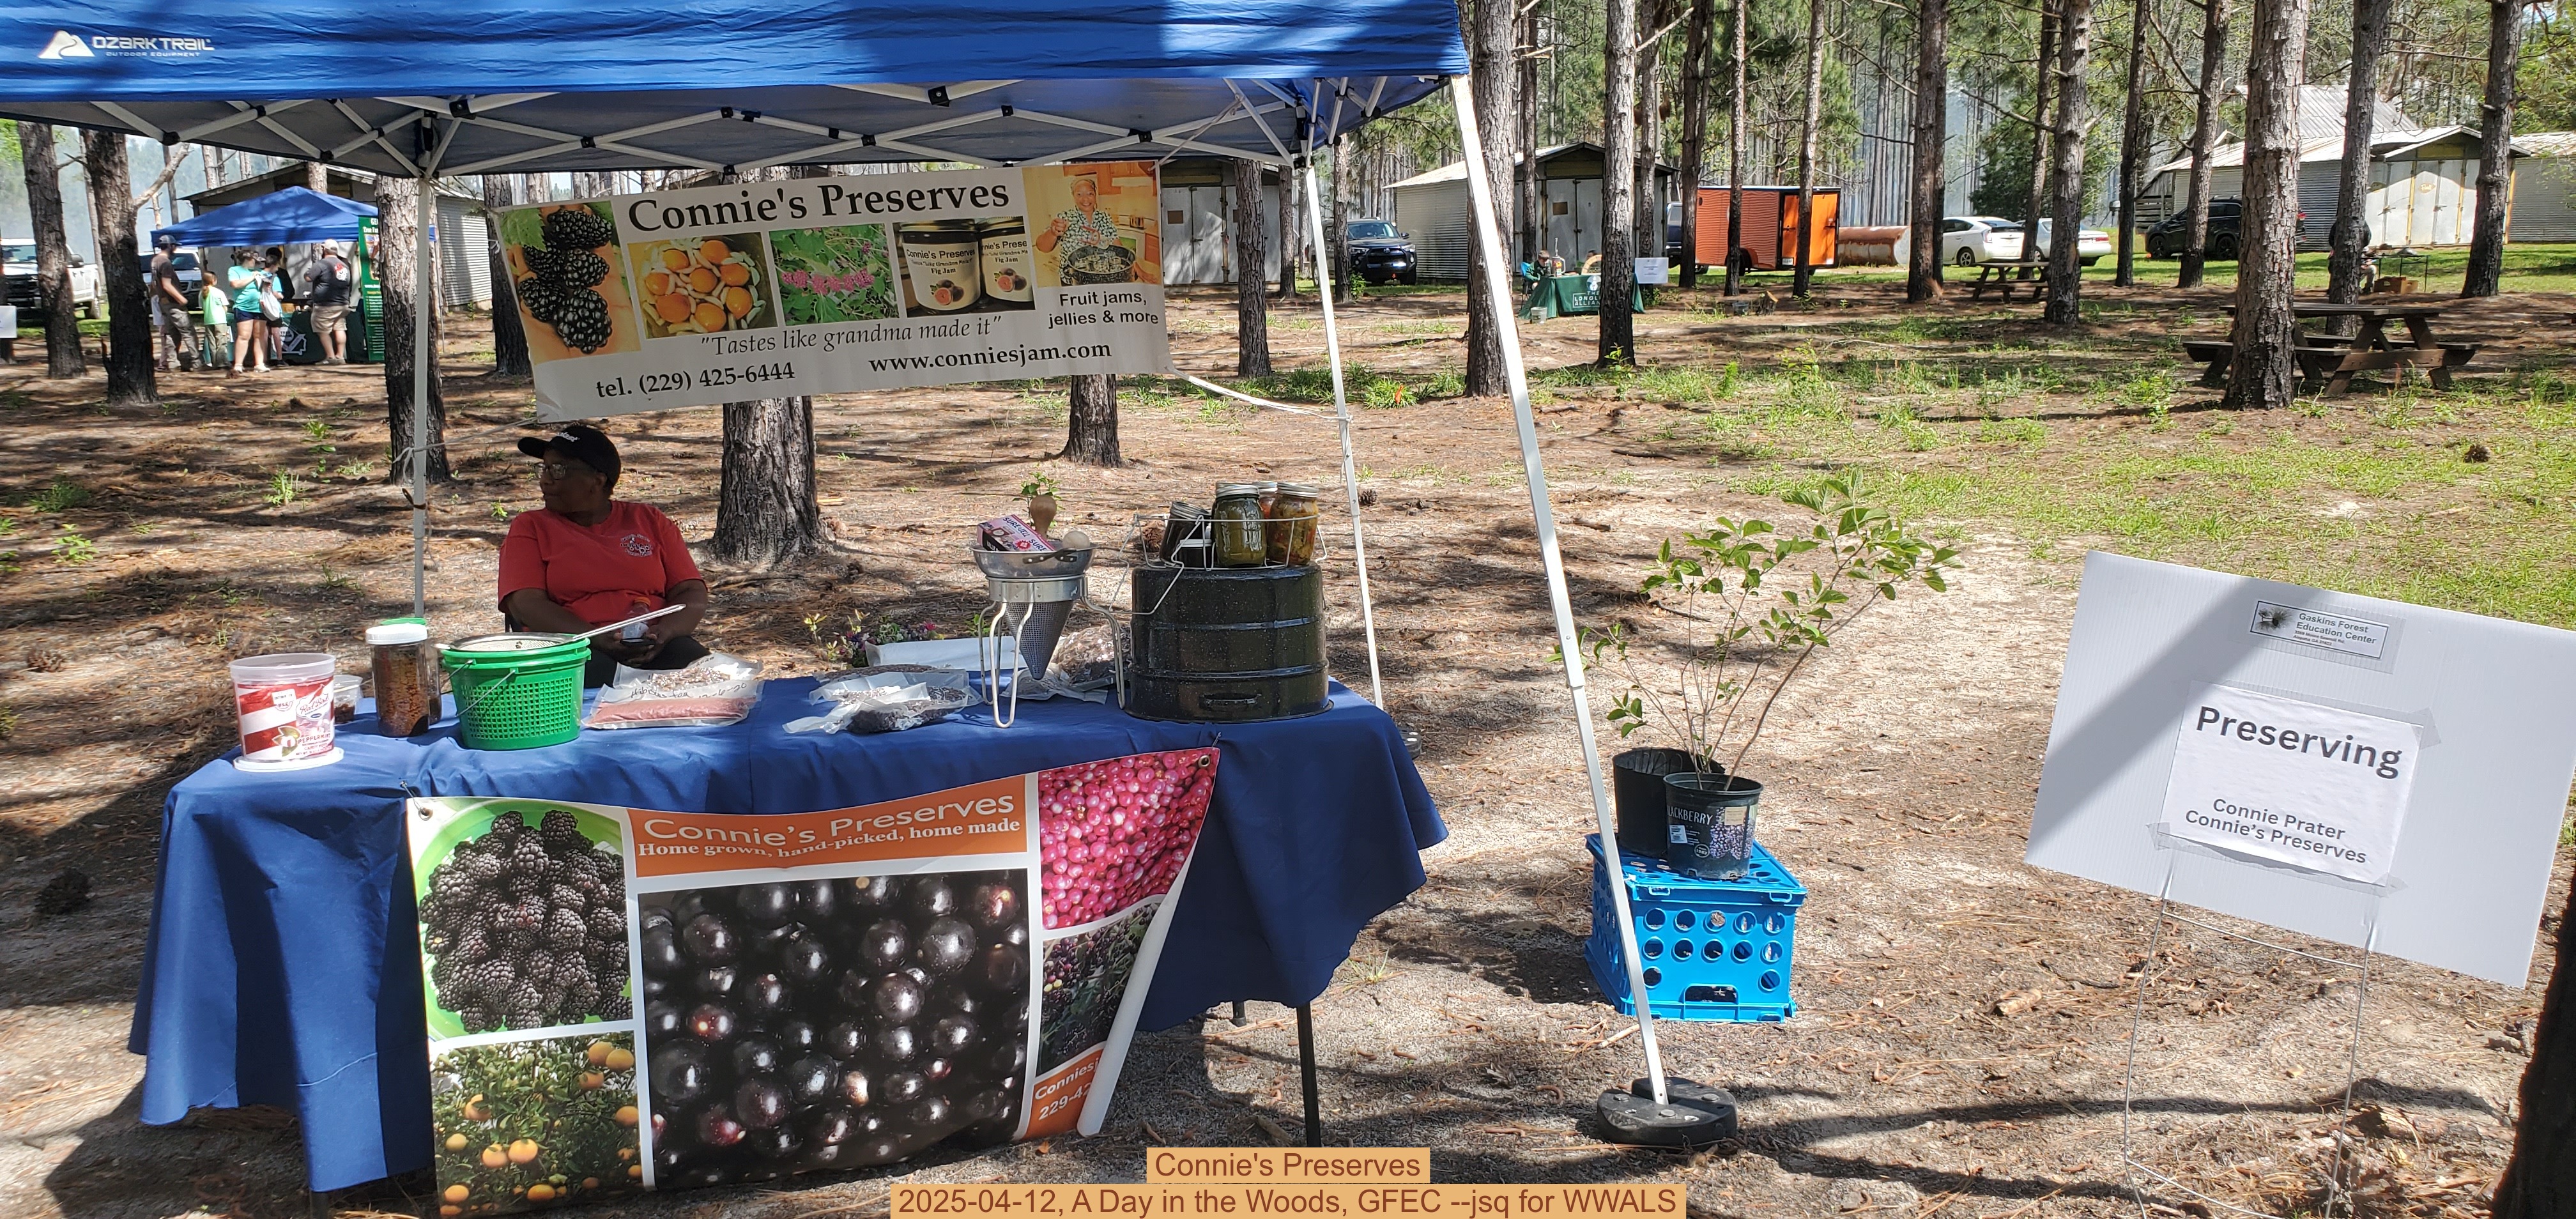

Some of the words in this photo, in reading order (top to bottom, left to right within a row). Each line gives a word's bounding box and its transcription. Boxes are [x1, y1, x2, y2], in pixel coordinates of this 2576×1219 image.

[628, 189, 807, 232] Connie's
[817, 184, 1009, 217] Preserves
[906, 249, 937, 259] Connie's
[939, 249, 976, 259] Preserves
[1059, 291, 1099, 307] Fruit
[1102, 291, 1147, 307] jams,
[702, 333, 776, 355] "Tastes
[783, 329, 817, 349] like
[824, 324, 913, 352] grandma
[919, 319, 970, 339] made
[977, 316, 1002, 335] it"
[1048, 312, 1096, 329] jellies
[1102, 311, 1115, 324] &
[1120, 312, 1159, 325] more
[868, 341, 1112, 372] www.conniesjam.com
[596, 377, 632, 398] tel.
[639, 371, 691, 395] (229)
[699, 362, 795, 387] 425-6444
[2296, 622, 2342, 638] Education
[2345, 632, 2377, 644] Center
[2299, 613, 2336, 626] Gaskins
[2338, 620, 2368, 633] Forest
[2196, 706, 2402, 779] Preserving
[644, 818, 816, 847] Connie's
[831, 795, 1015, 837] Preserves
[2186, 809, 2265, 839] Connie's
[2270, 829, 2366, 863] Preserves
[2213, 799, 2278, 824] Connie
[2284, 814, 2345, 839] Prater
[639, 843, 700, 856] Home
[704, 844, 773, 859] grown,
[778, 829, 905, 857] hand-picked,
[909, 825, 966, 839] home
[968, 818, 1020, 832] made
